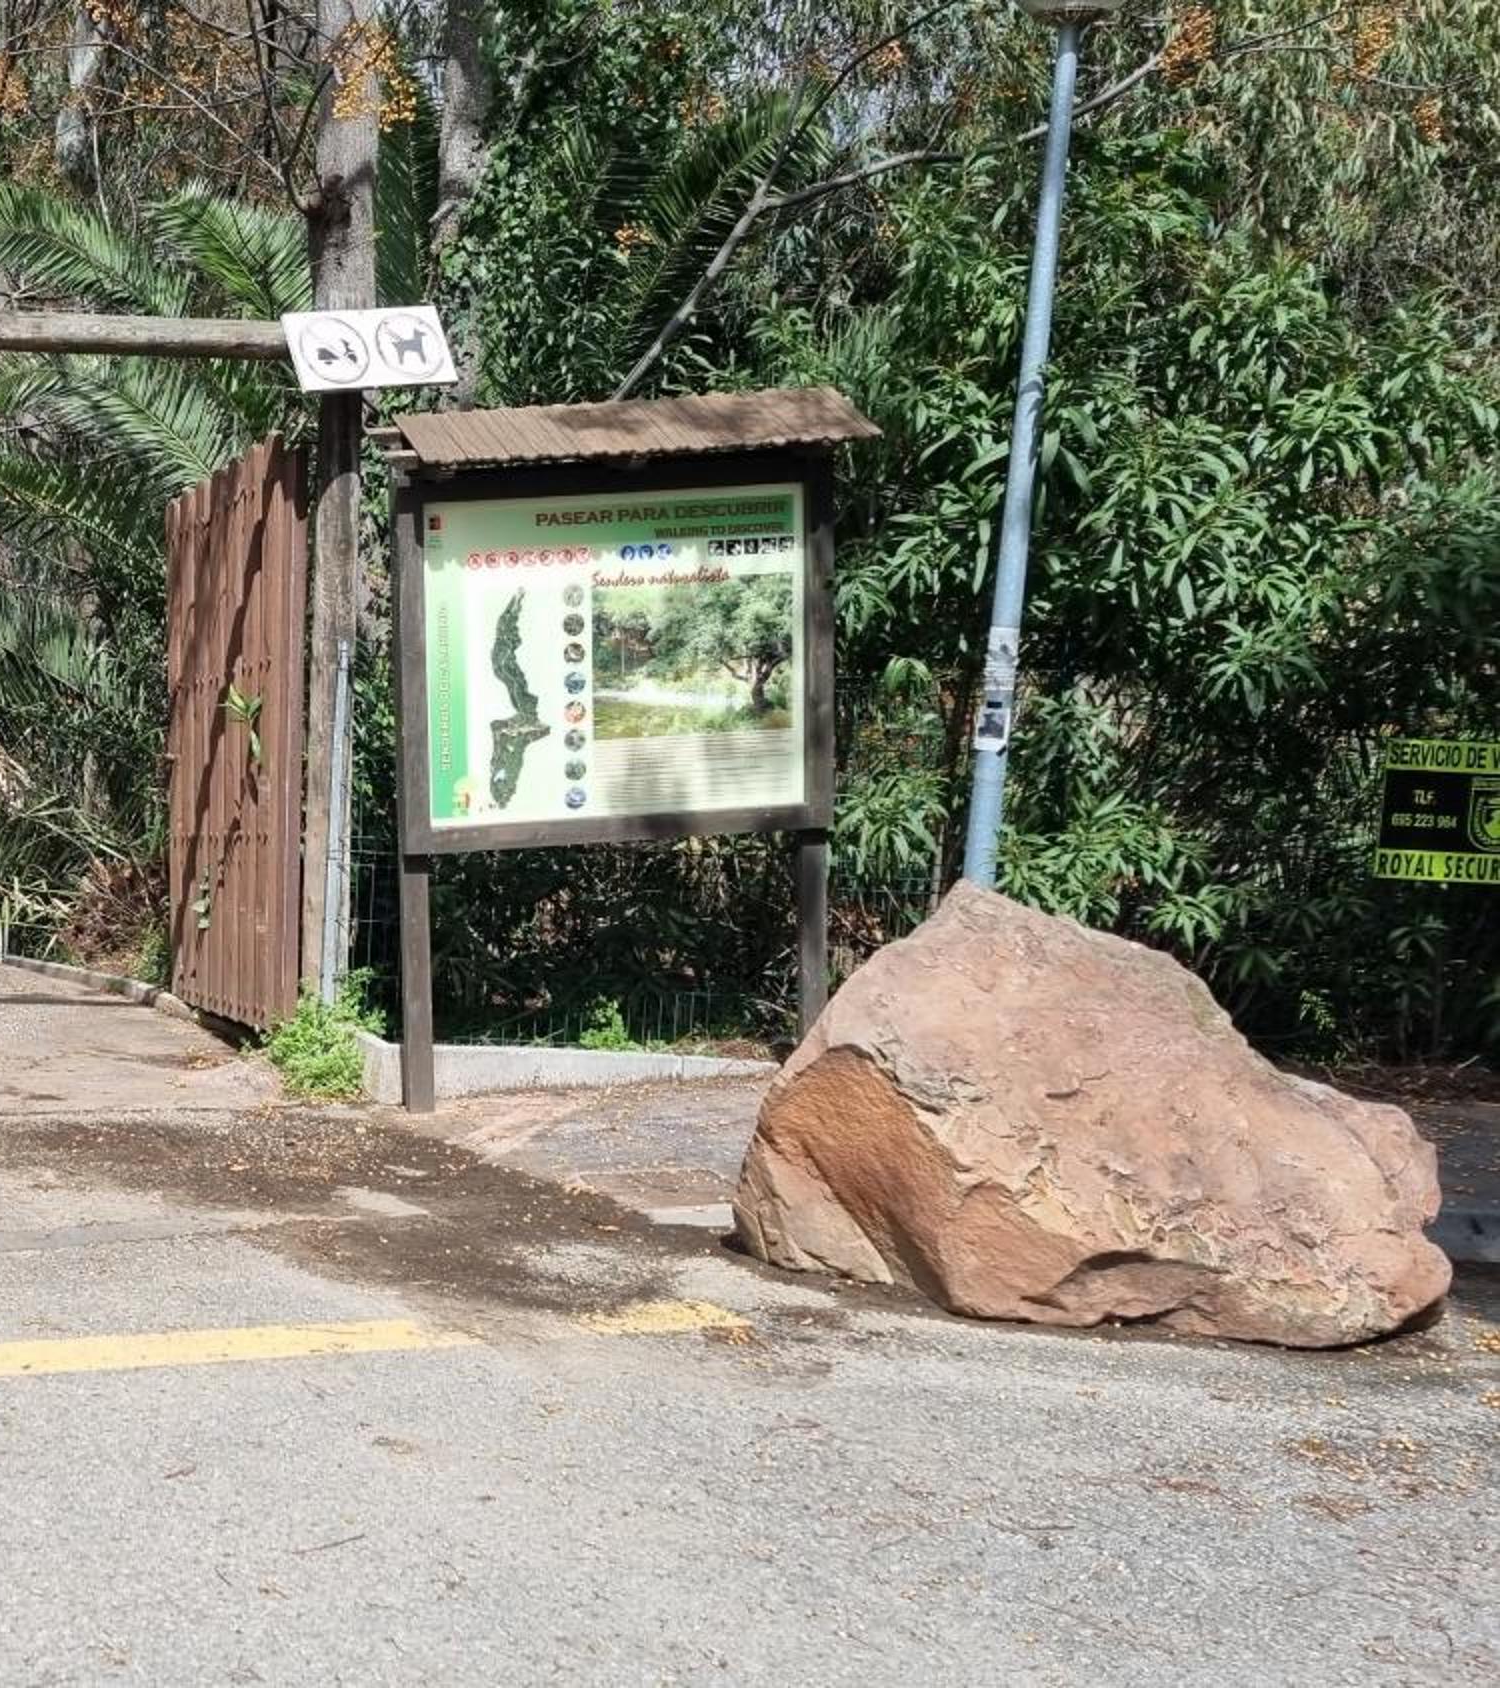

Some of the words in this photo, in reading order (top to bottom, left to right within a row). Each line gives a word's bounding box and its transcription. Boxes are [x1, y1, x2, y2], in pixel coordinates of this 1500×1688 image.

[535, 509, 613, 527] PASEAR
[617, 507, 669, 523] PARA
[674, 500, 786, 520] DESCUBRIR
[654, 526, 709, 540] WALKING
[709, 525, 726, 537] TO
[1389, 743, 1462, 768] SERVICIO
[1466, 746, 1488, 768] DE
[1413, 814, 1435, 827] 223
[1377, 854, 1434, 877] ROYAL
